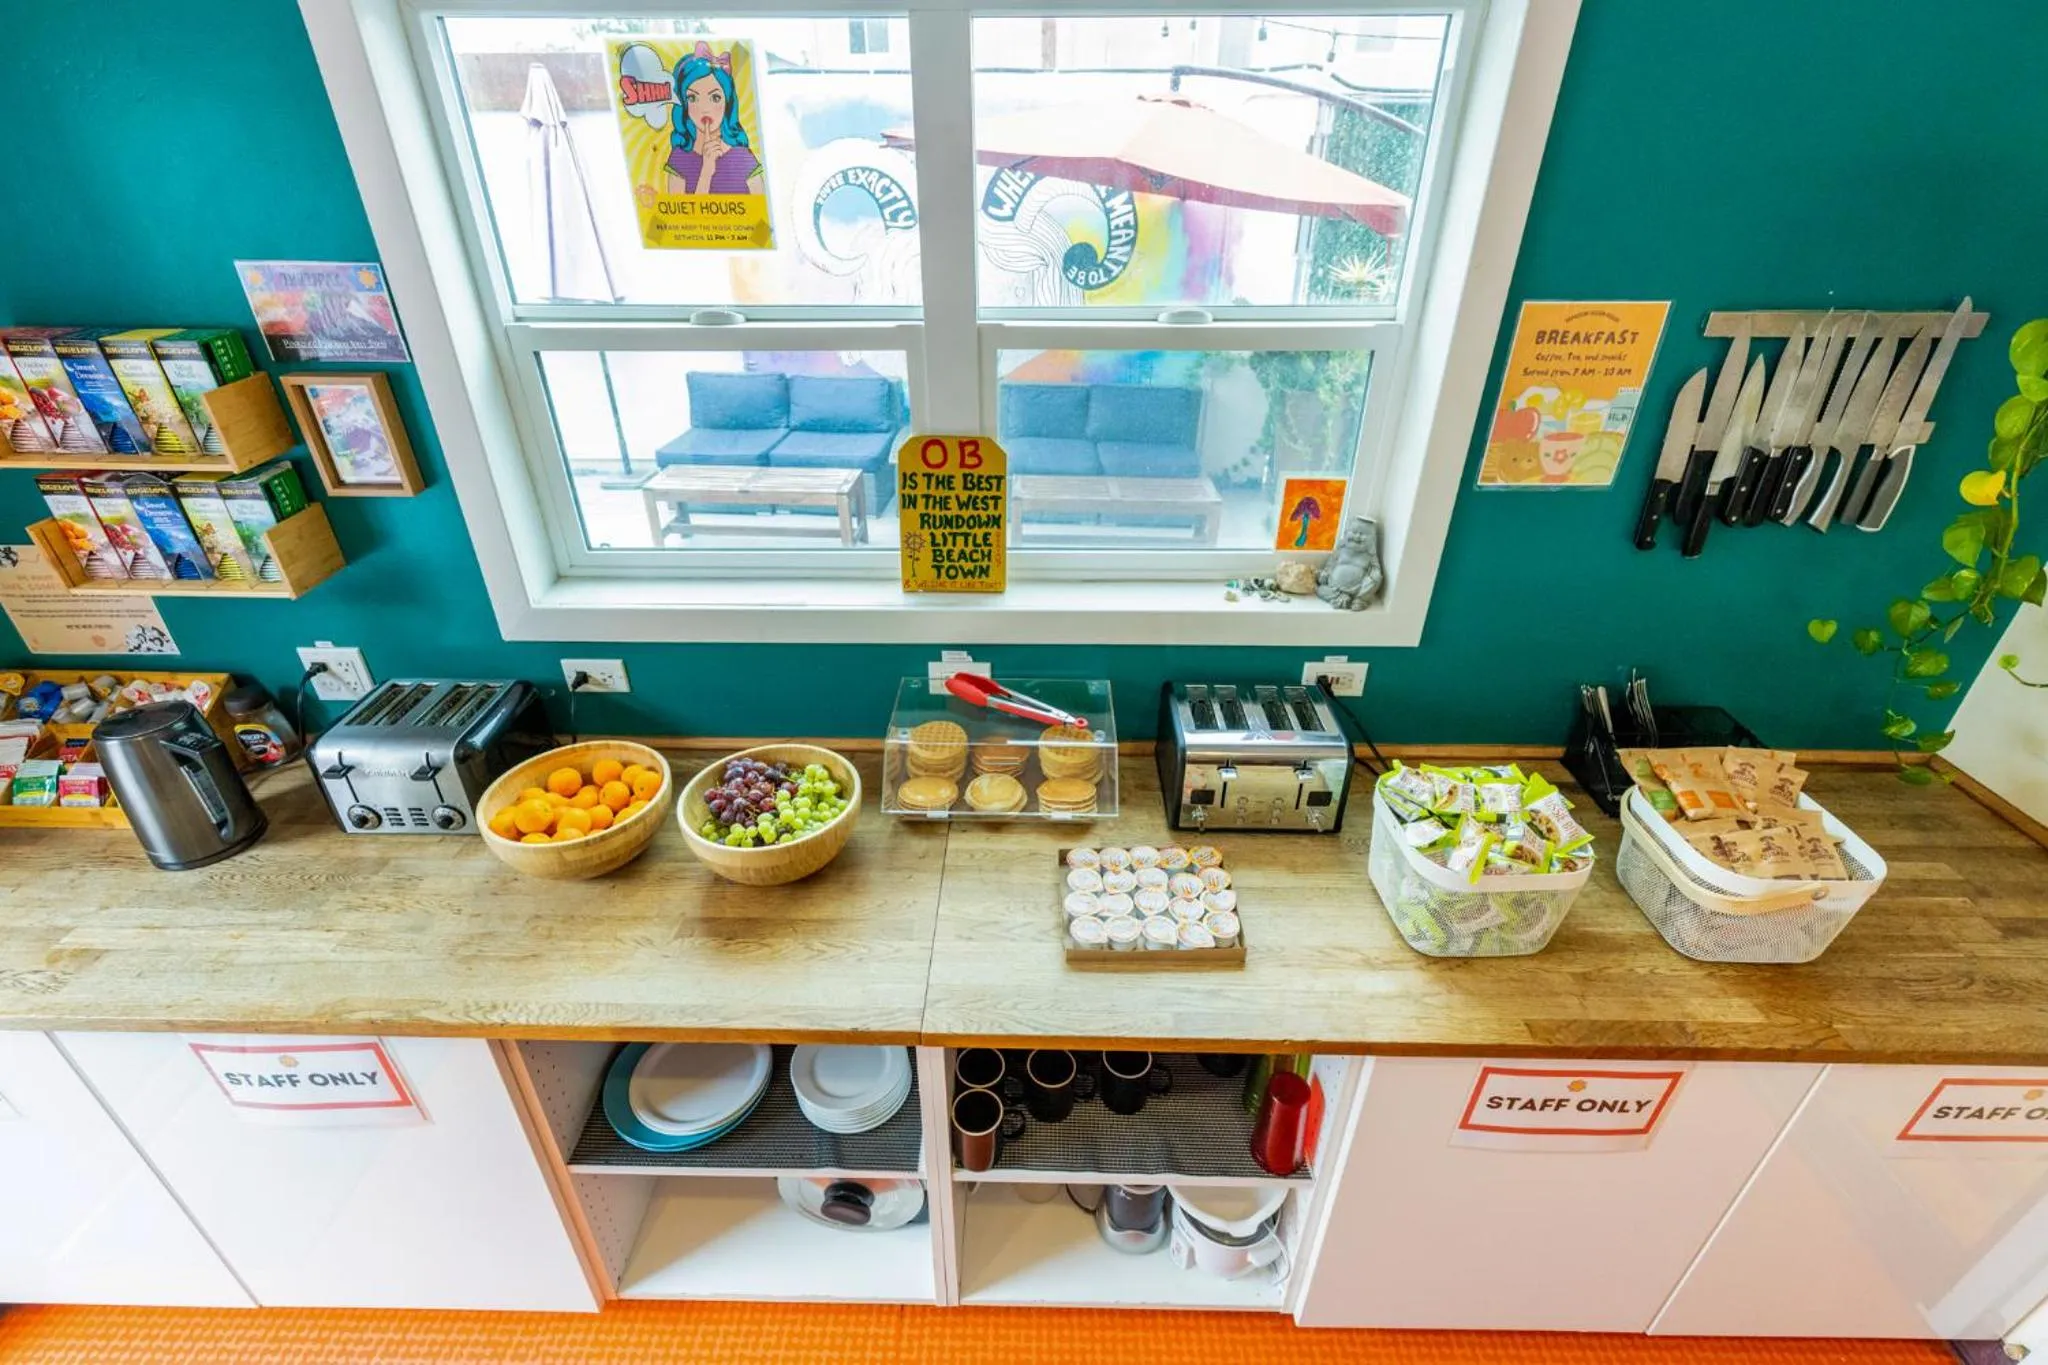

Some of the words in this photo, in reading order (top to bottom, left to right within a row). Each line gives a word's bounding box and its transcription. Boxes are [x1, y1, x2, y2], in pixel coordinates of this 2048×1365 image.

[847, 168, 917, 227] EXACTLY
[658, 201, 696, 215] QUIET
[700, 201, 746, 215] HOURS
[1103, 189, 1136, 278] MEANT
[1087, 270, 1110, 285] TO
[1535, 329, 1639, 345] BREAKFAST
[1581, 367, 1596, 376] AM
[1616, 367, 1632, 376] AM
[902, 472, 918, 490] IS
[922, 473, 955, 490] THE
[962, 473, 1005, 491] BEST
[902, 494, 917, 509] IN
[921, 494, 952, 510] THE
[955, 494, 1002, 511] WEST
[919, 513, 1002, 530] RUNDOWN
[929, 532, 993, 548] LITTLE
[932, 549, 992, 563] BEACH
[931, 564, 990, 580] TOWN
[223, 1072, 300, 1088] STAFF
[308, 1071, 378, 1087] ONLY
[1486, 1095, 1570, 1112] STAFF
[1576, 1098, 1653, 1113] ONLY
[1932, 1106, 2021, 1120] STAFF
[2025, 1107, 2048, 1120] O
